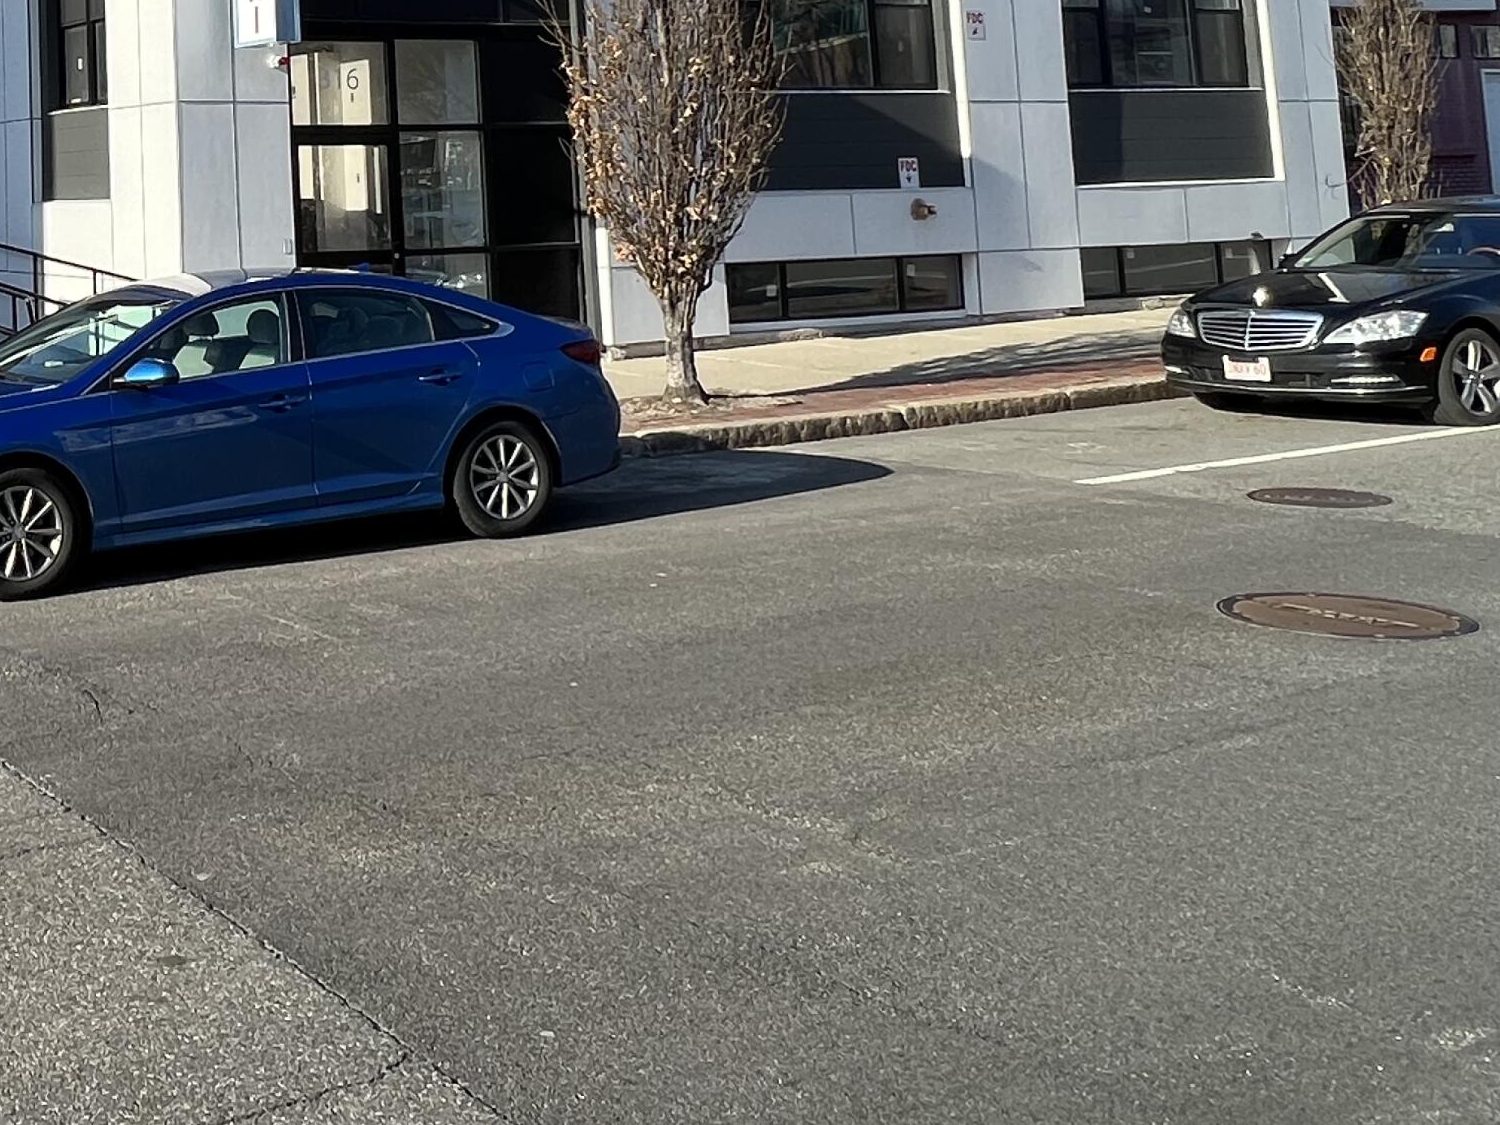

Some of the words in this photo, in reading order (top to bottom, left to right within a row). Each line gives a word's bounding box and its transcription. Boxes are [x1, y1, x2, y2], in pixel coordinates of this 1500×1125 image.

[966, 11, 984, 24] FDC
[346, 68, 359, 90] 6
[901, 160, 917, 172] FDC
